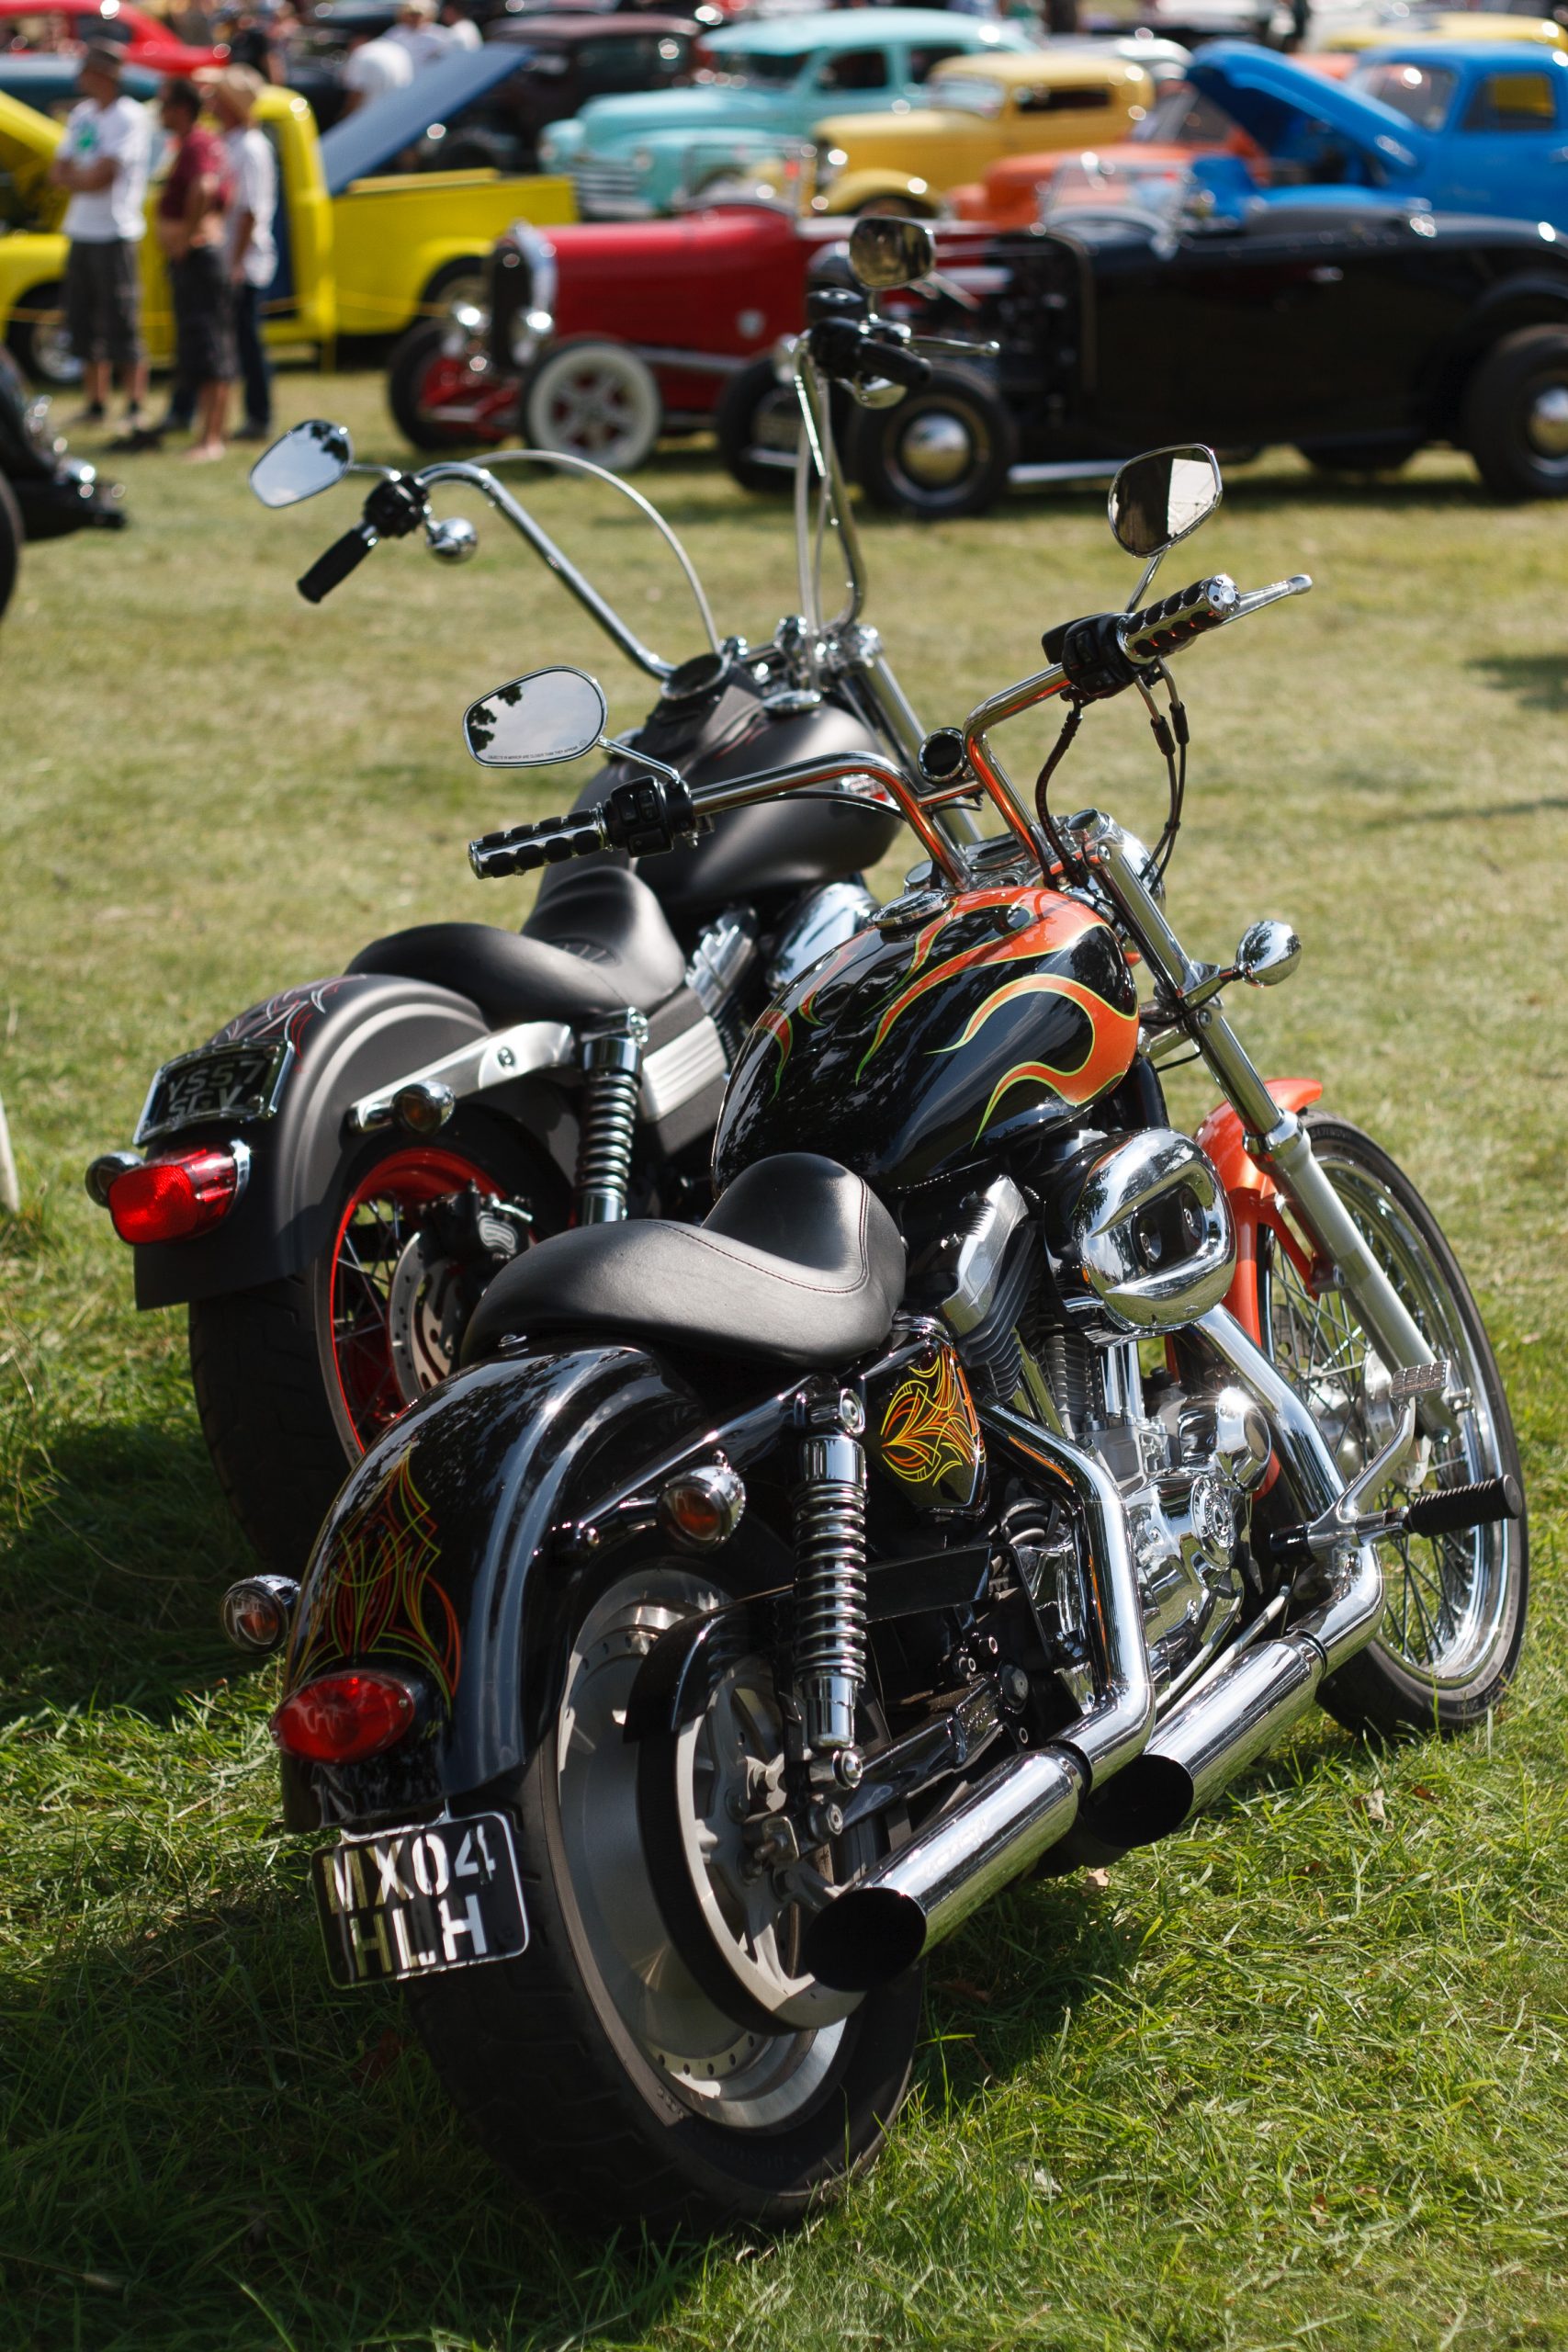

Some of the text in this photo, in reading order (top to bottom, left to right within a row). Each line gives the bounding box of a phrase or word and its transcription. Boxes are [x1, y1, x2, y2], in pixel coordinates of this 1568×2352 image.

[169, 1060, 266, 1102] YS57
[322, 1824, 497, 1915] MX04
[349, 1894, 487, 1977] HLH
